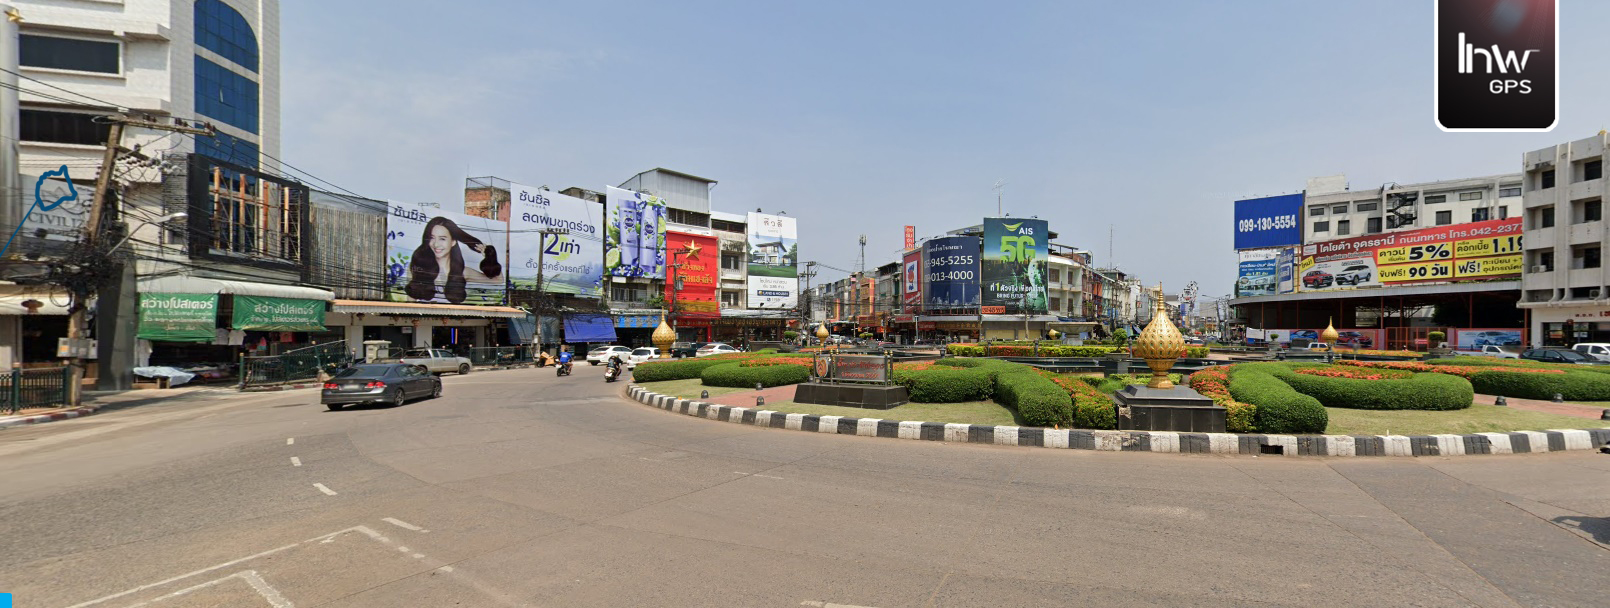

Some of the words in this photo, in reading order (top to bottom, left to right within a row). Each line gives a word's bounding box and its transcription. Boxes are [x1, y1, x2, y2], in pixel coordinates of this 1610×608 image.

[28, 211, 86, 229] CIVILIZ
[522, 212, 595, 234] ลดผมขาดร่วง
[1239, 214, 1297, 233] 099-130-5554
[1018, 227, 1034, 235] AIS
[1353, 235, 1395, 251] อุดรธานี
[1399, 232, 1446, 245] ถนนทหาร
[1449, 223, 1523, 239] โทร.042-237
[1000, 235, 1036, 264] 5G
[1379, 247, 1406, 258] ดาวน์
[1457, 240, 1489, 252] ดอกเบี้ย
[1431, 263, 1449, 276] วัน
[1458, 260, 1481, 274] ฟรี!
[141, 297, 214, 309] สว่างโปสเตอร์
[254, 301, 315, 315] สว่างโปสเตอร์
